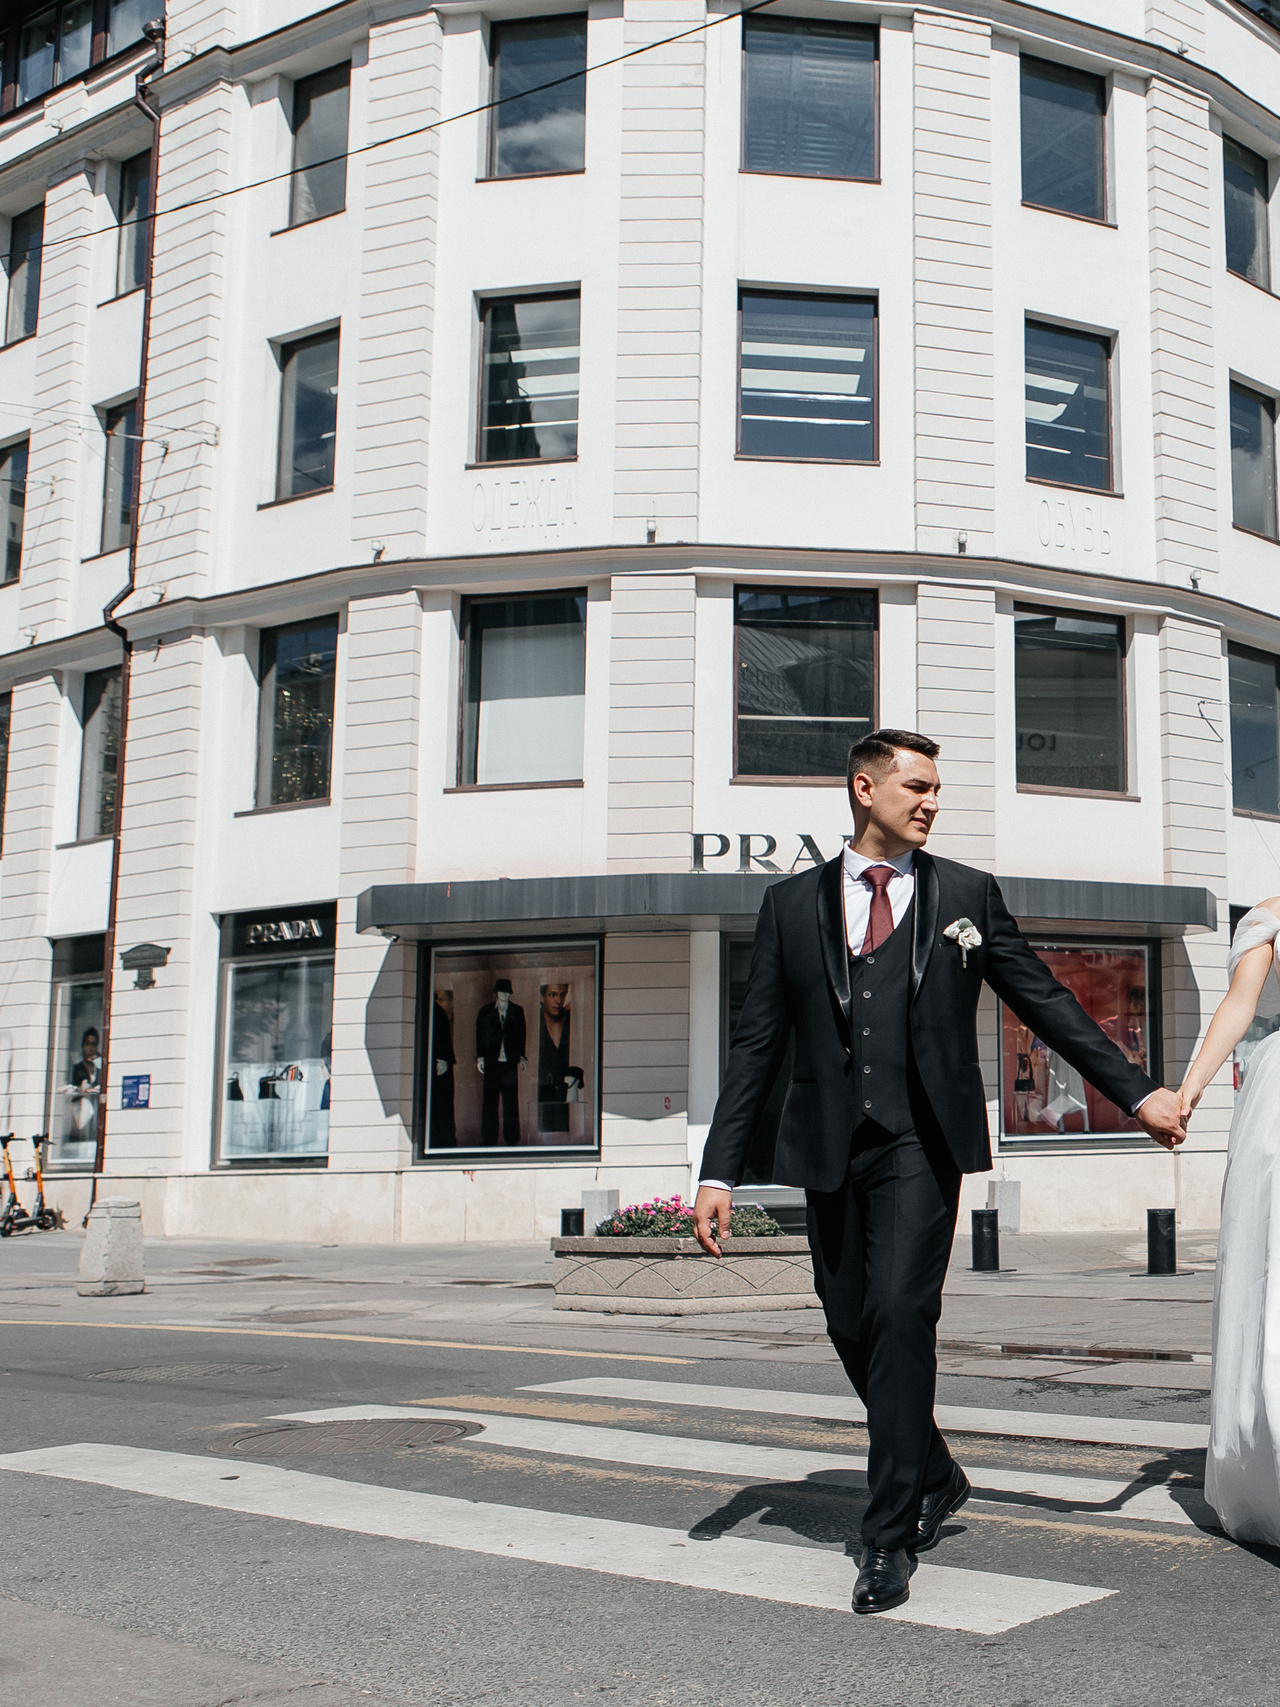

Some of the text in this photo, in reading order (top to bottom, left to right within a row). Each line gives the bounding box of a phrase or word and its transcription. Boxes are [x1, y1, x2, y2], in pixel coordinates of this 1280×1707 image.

[472, 478, 577, 542] ОДЕЖДА
[1037, 499, 1111, 555] ОБУВЬ
[688, 832, 853, 872] PRA
[246, 918, 322, 944] PRADA
